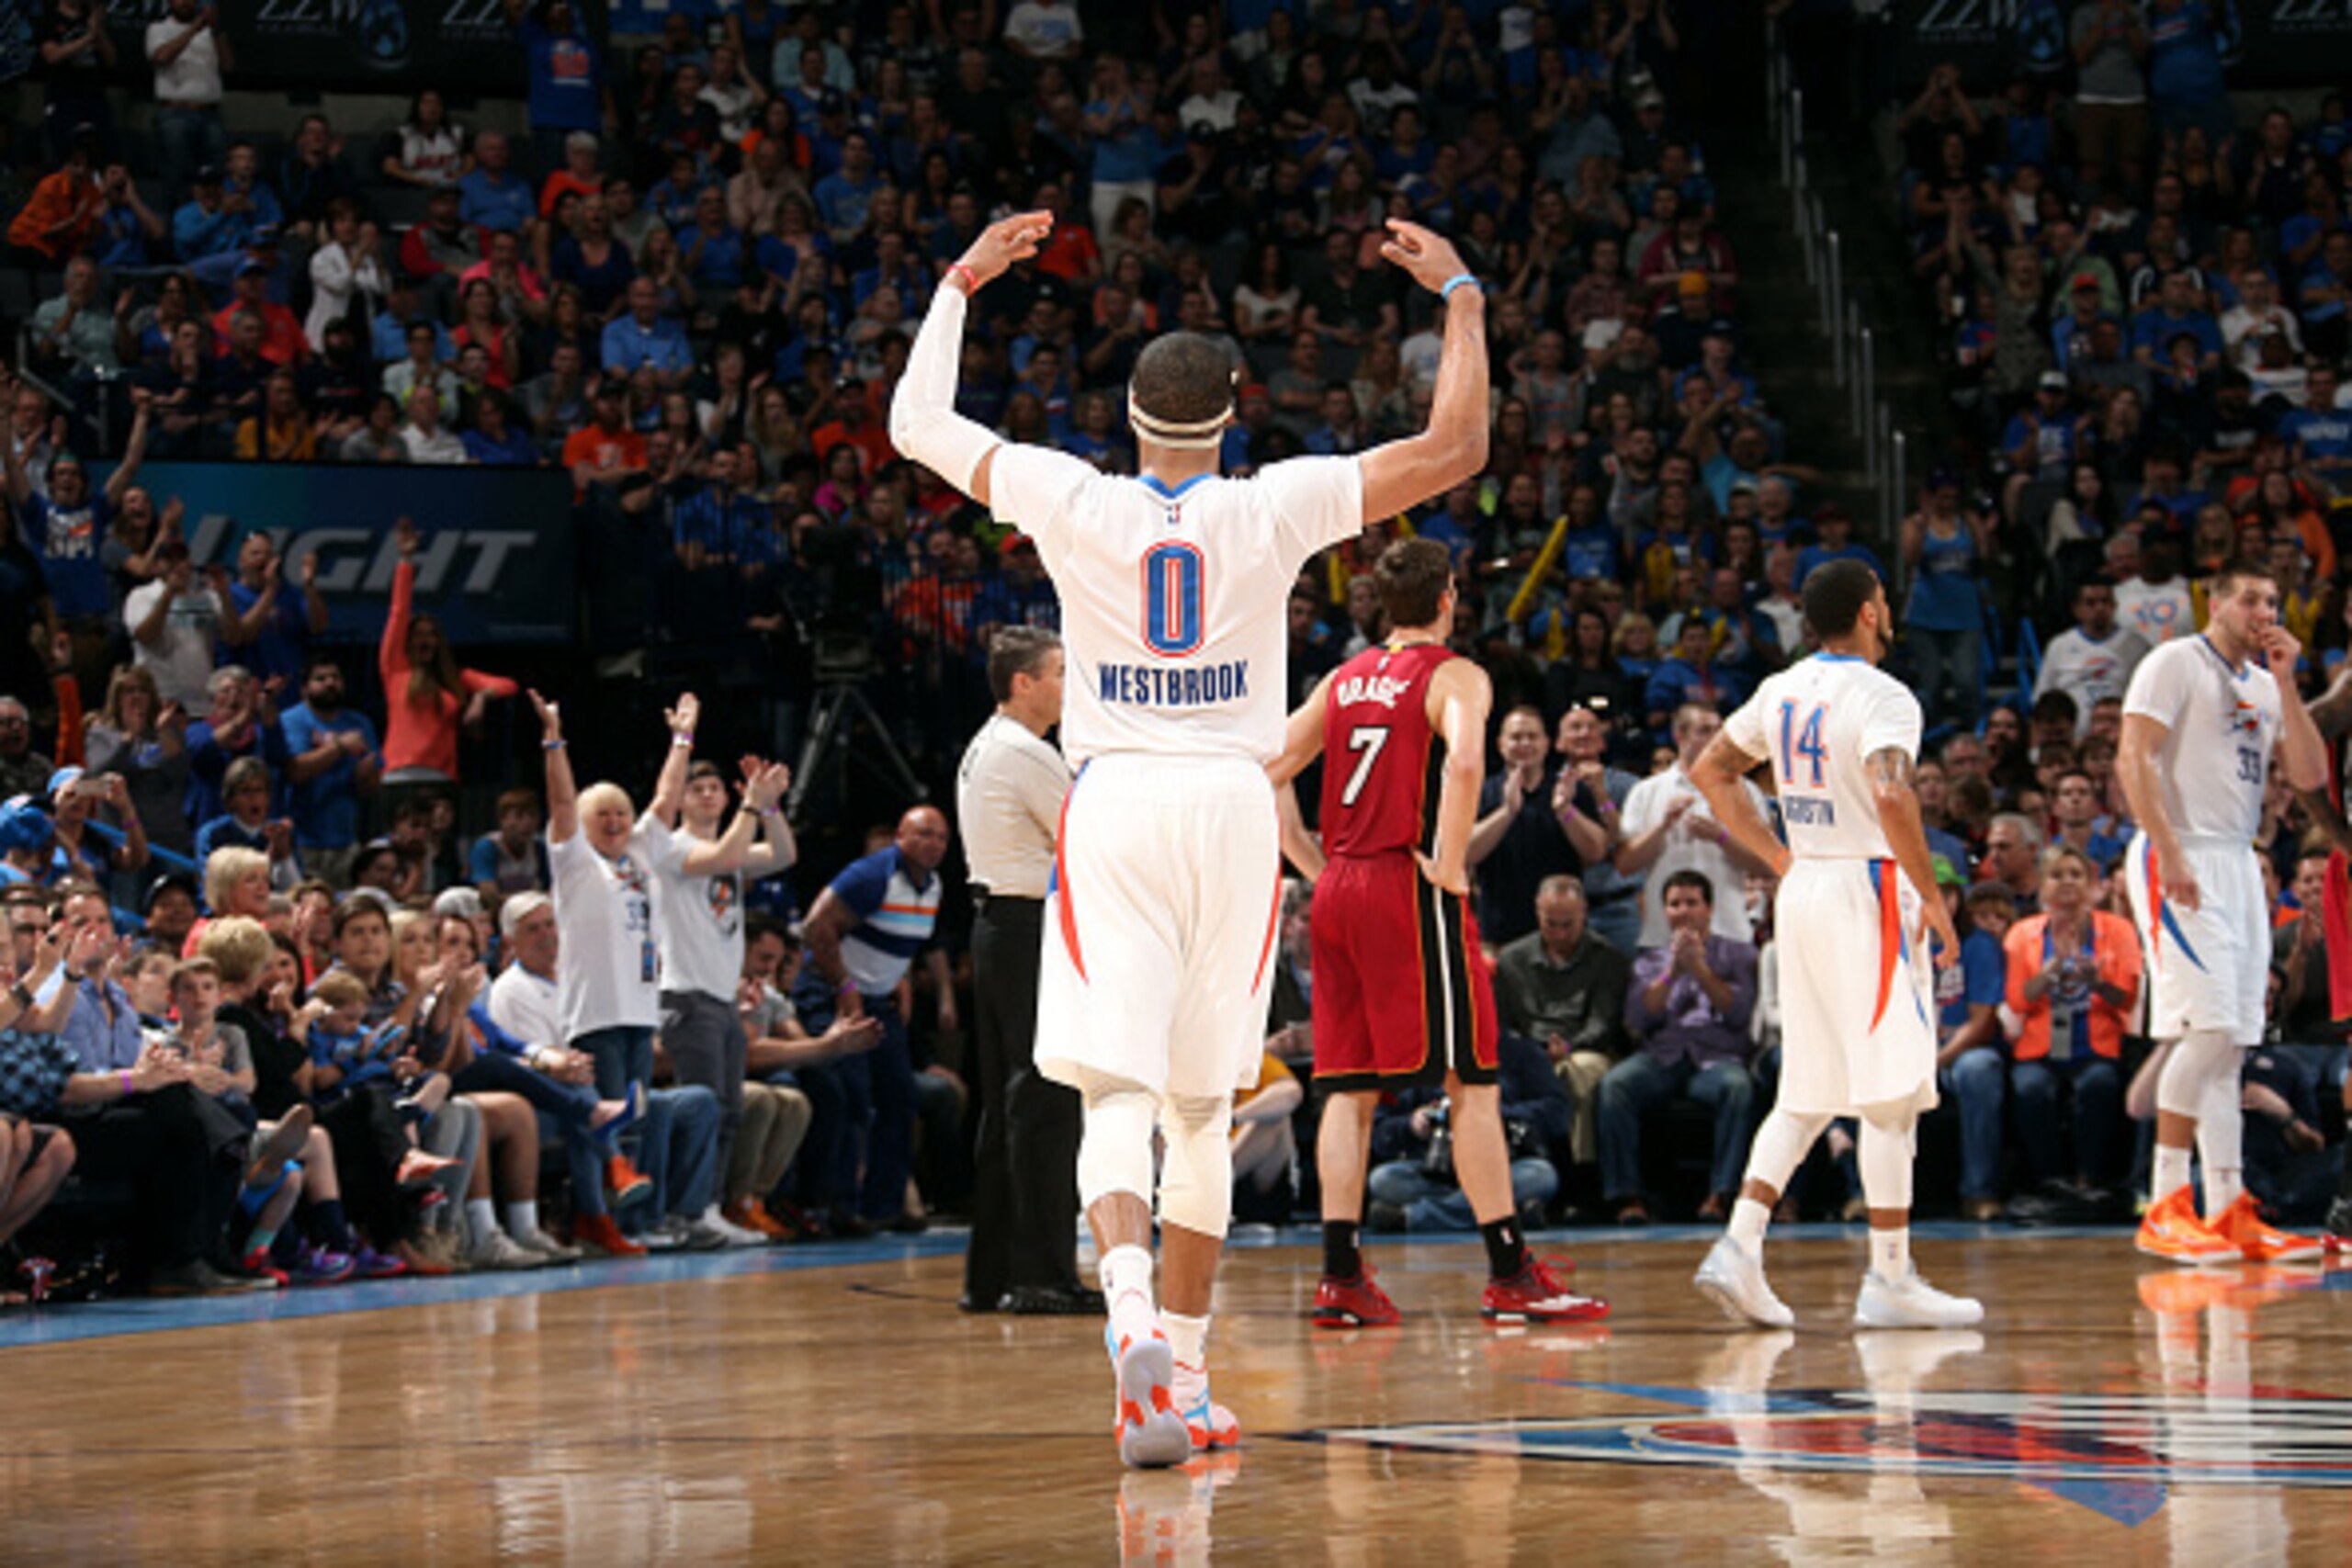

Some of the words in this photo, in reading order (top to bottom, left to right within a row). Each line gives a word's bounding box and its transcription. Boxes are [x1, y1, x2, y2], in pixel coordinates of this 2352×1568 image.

[1139, 538, 1204, 659] 0
[1097, 660, 1249, 705] WESTBROOK
[1340, 725, 1391, 807] 7
[1777, 696, 1830, 787] 14
